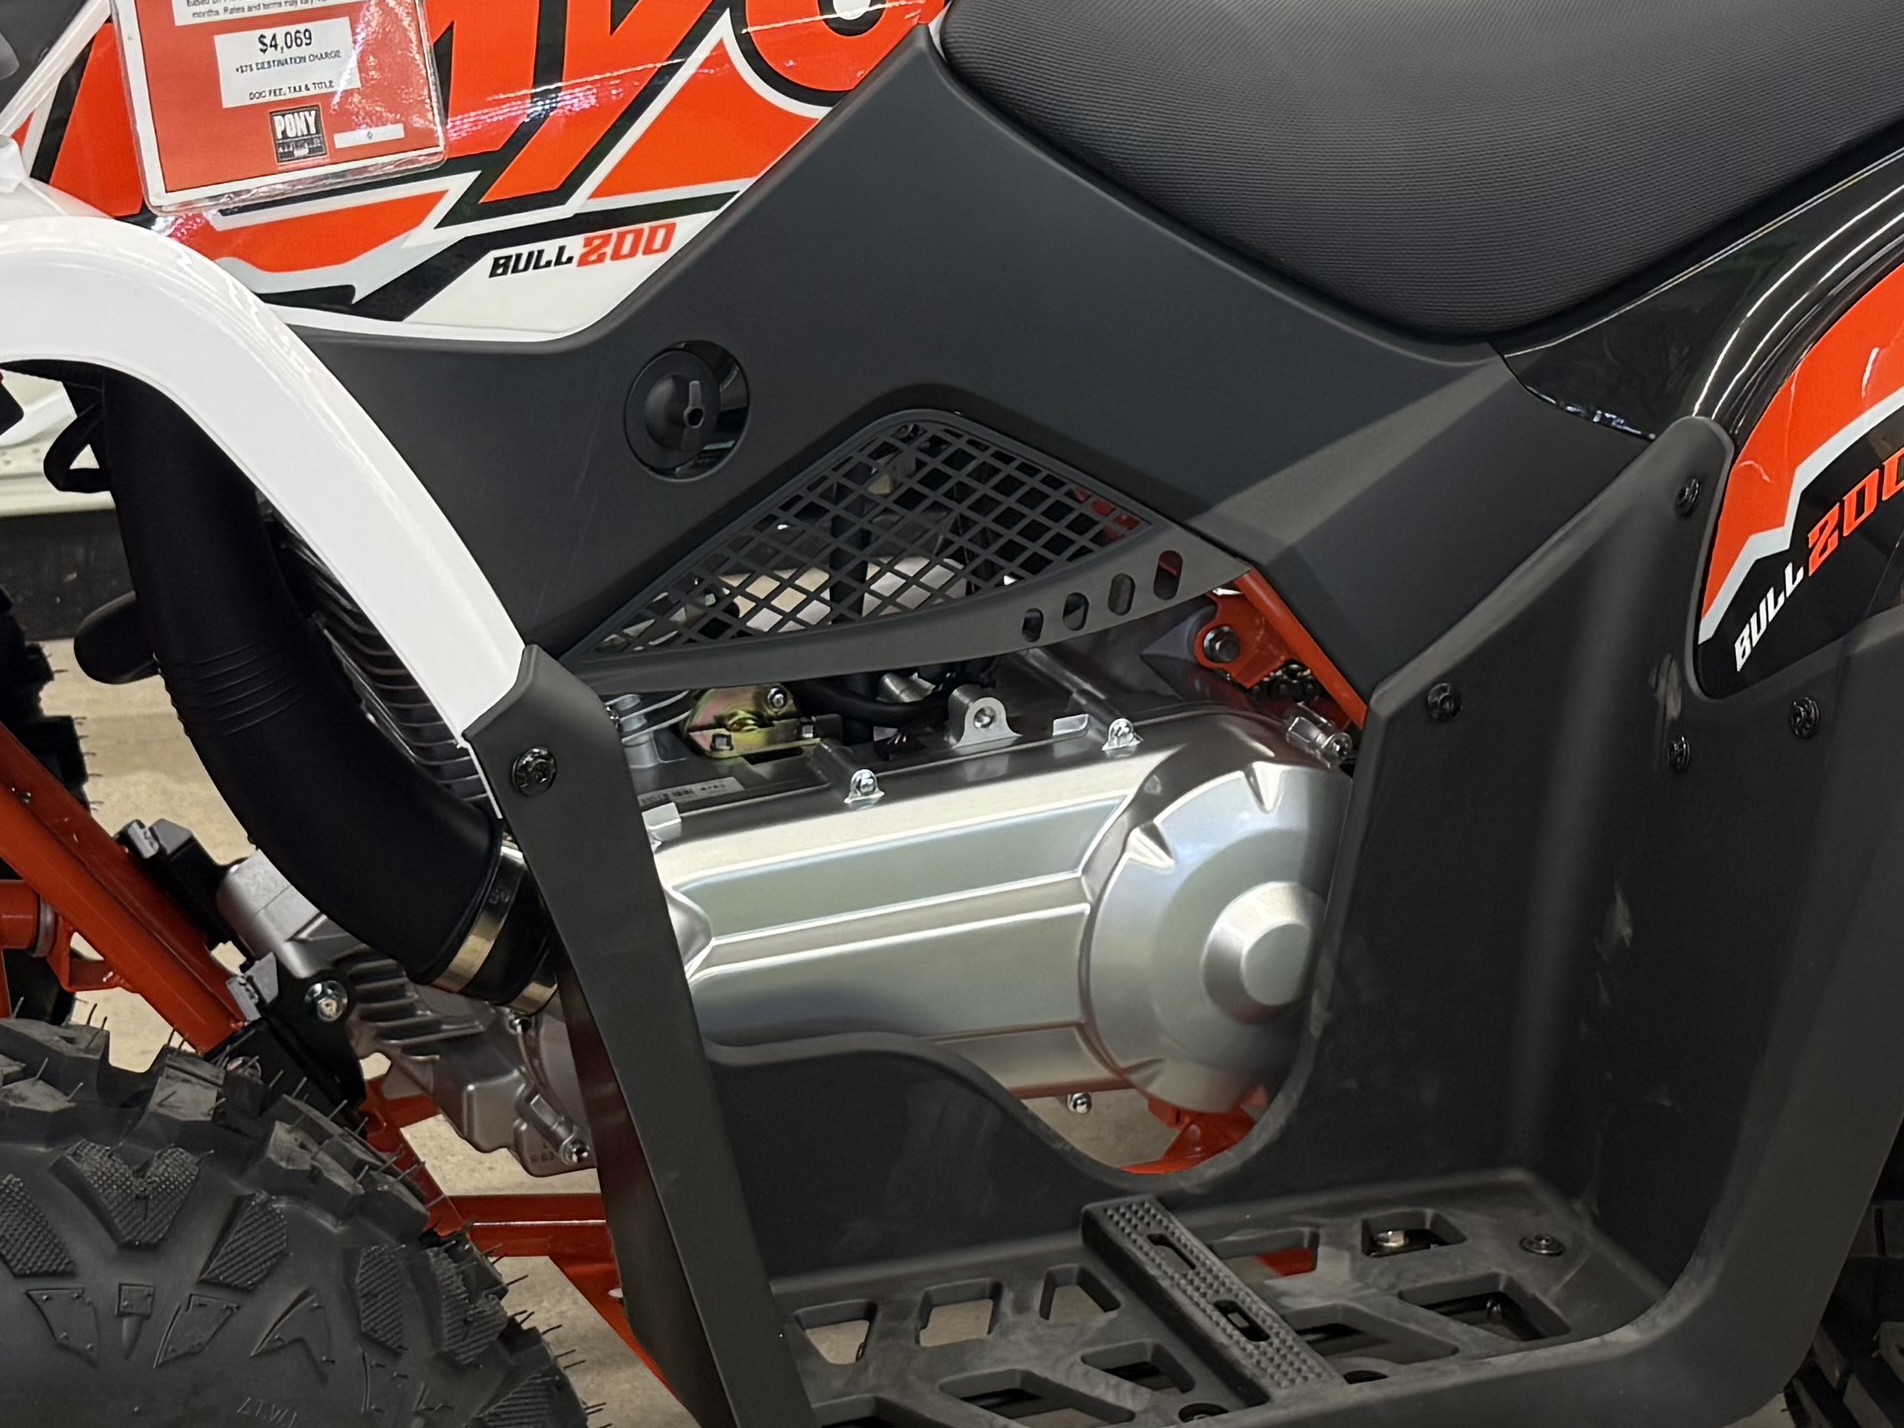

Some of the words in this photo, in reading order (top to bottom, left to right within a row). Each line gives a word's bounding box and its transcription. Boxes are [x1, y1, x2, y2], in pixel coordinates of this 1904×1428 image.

[258, 28, 313, 55] $4,069
[273, 110, 316, 139] PONY
[489, 245, 575, 277] BULL
[574, 222, 678, 267] 200
[1733, 560, 1807, 673] BULL
